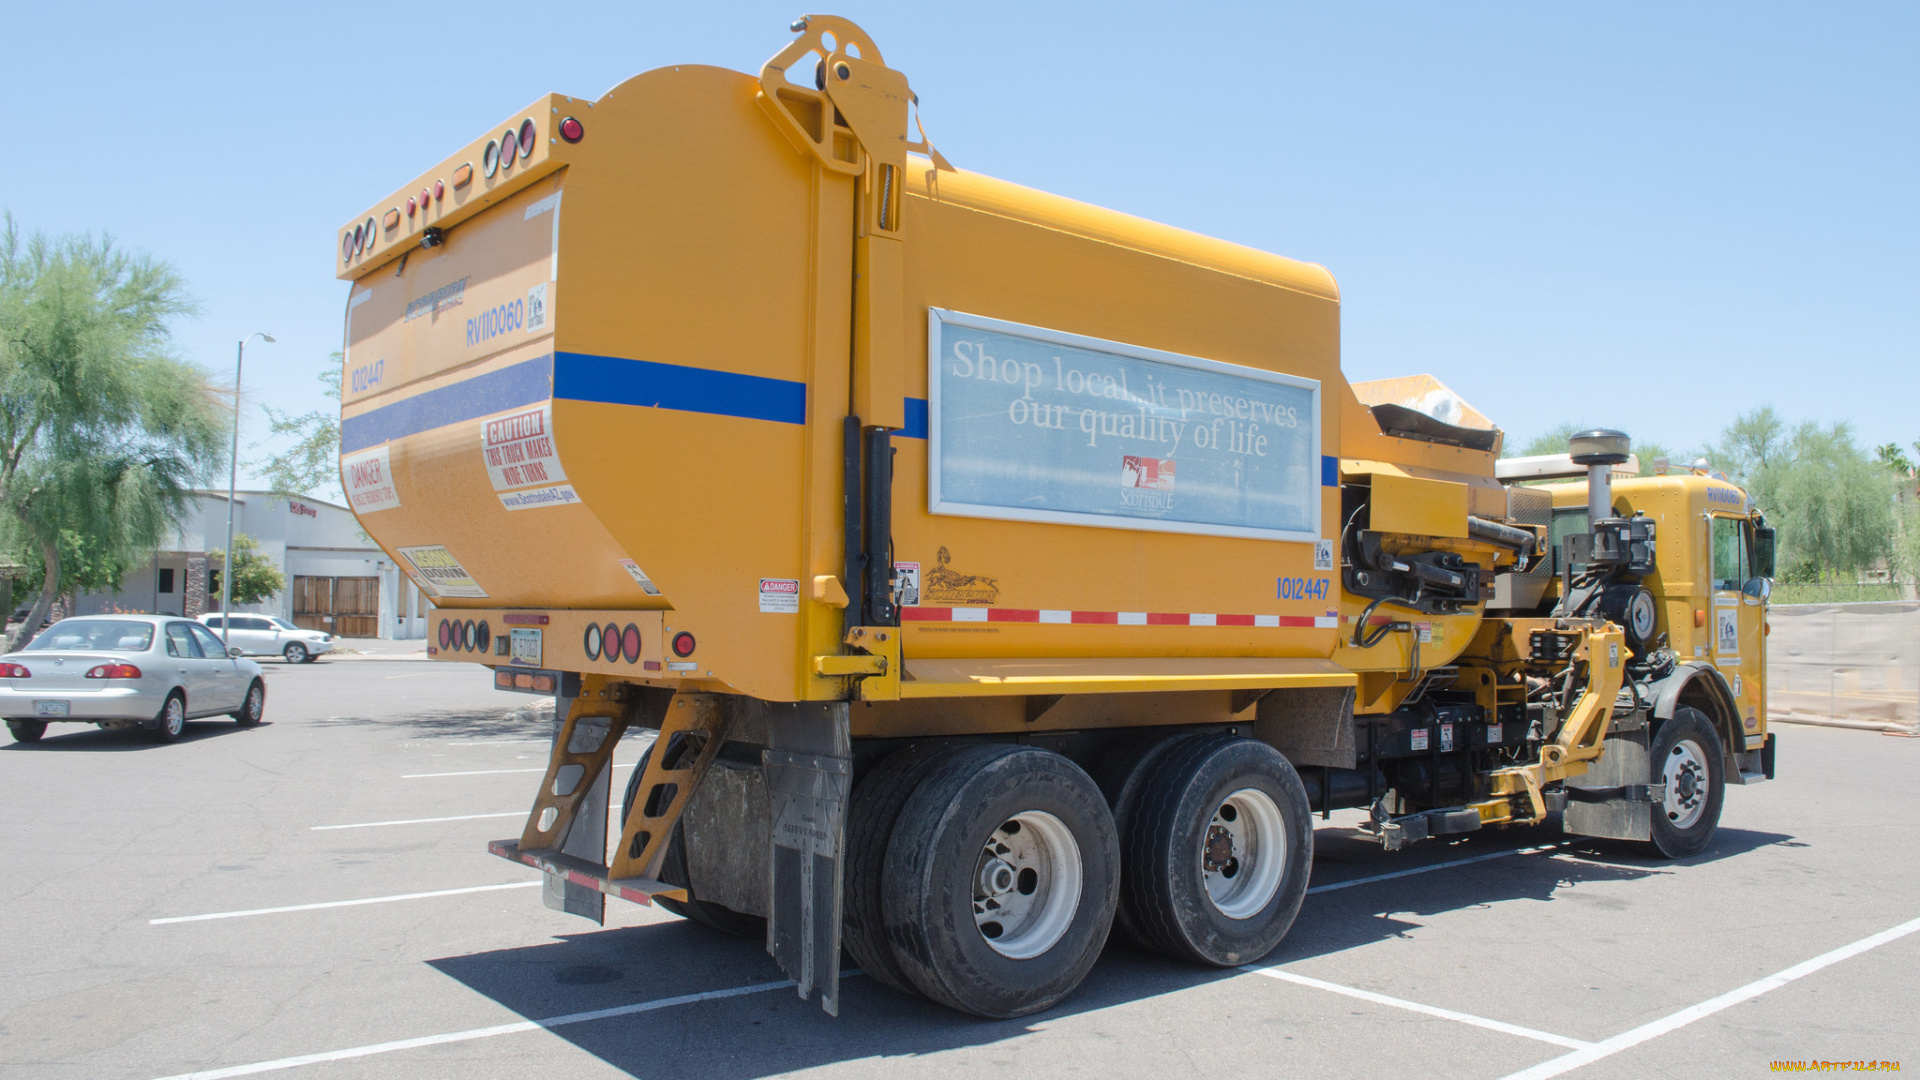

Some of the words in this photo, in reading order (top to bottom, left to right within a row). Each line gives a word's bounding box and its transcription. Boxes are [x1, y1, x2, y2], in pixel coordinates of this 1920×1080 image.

[466, 298, 523, 348] RV110060
[351, 359, 384, 395] 1012447
[953, 340, 1042, 400] Shop
[1176, 387, 1297, 428] preserves
[490, 413, 541, 444] CAUTION
[1009, 399, 1072, 430] our
[1079, 406, 1185, 456] quality
[1193, 418, 1224, 449] of
[1230, 420, 1268, 456] life
[486, 447, 503, 468] THIS
[501, 442, 526, 465] TRUCK
[525, 437, 553, 461] MAKES
[351, 458, 383, 489] DANGER
[502, 466, 524, 487] WIDE
[520, 462, 549, 483] TURNS
[422, 568, 469, 578] DOWN
[770, 582, 795, 592] DANGER
[1277, 577, 1330, 600] 1012447
